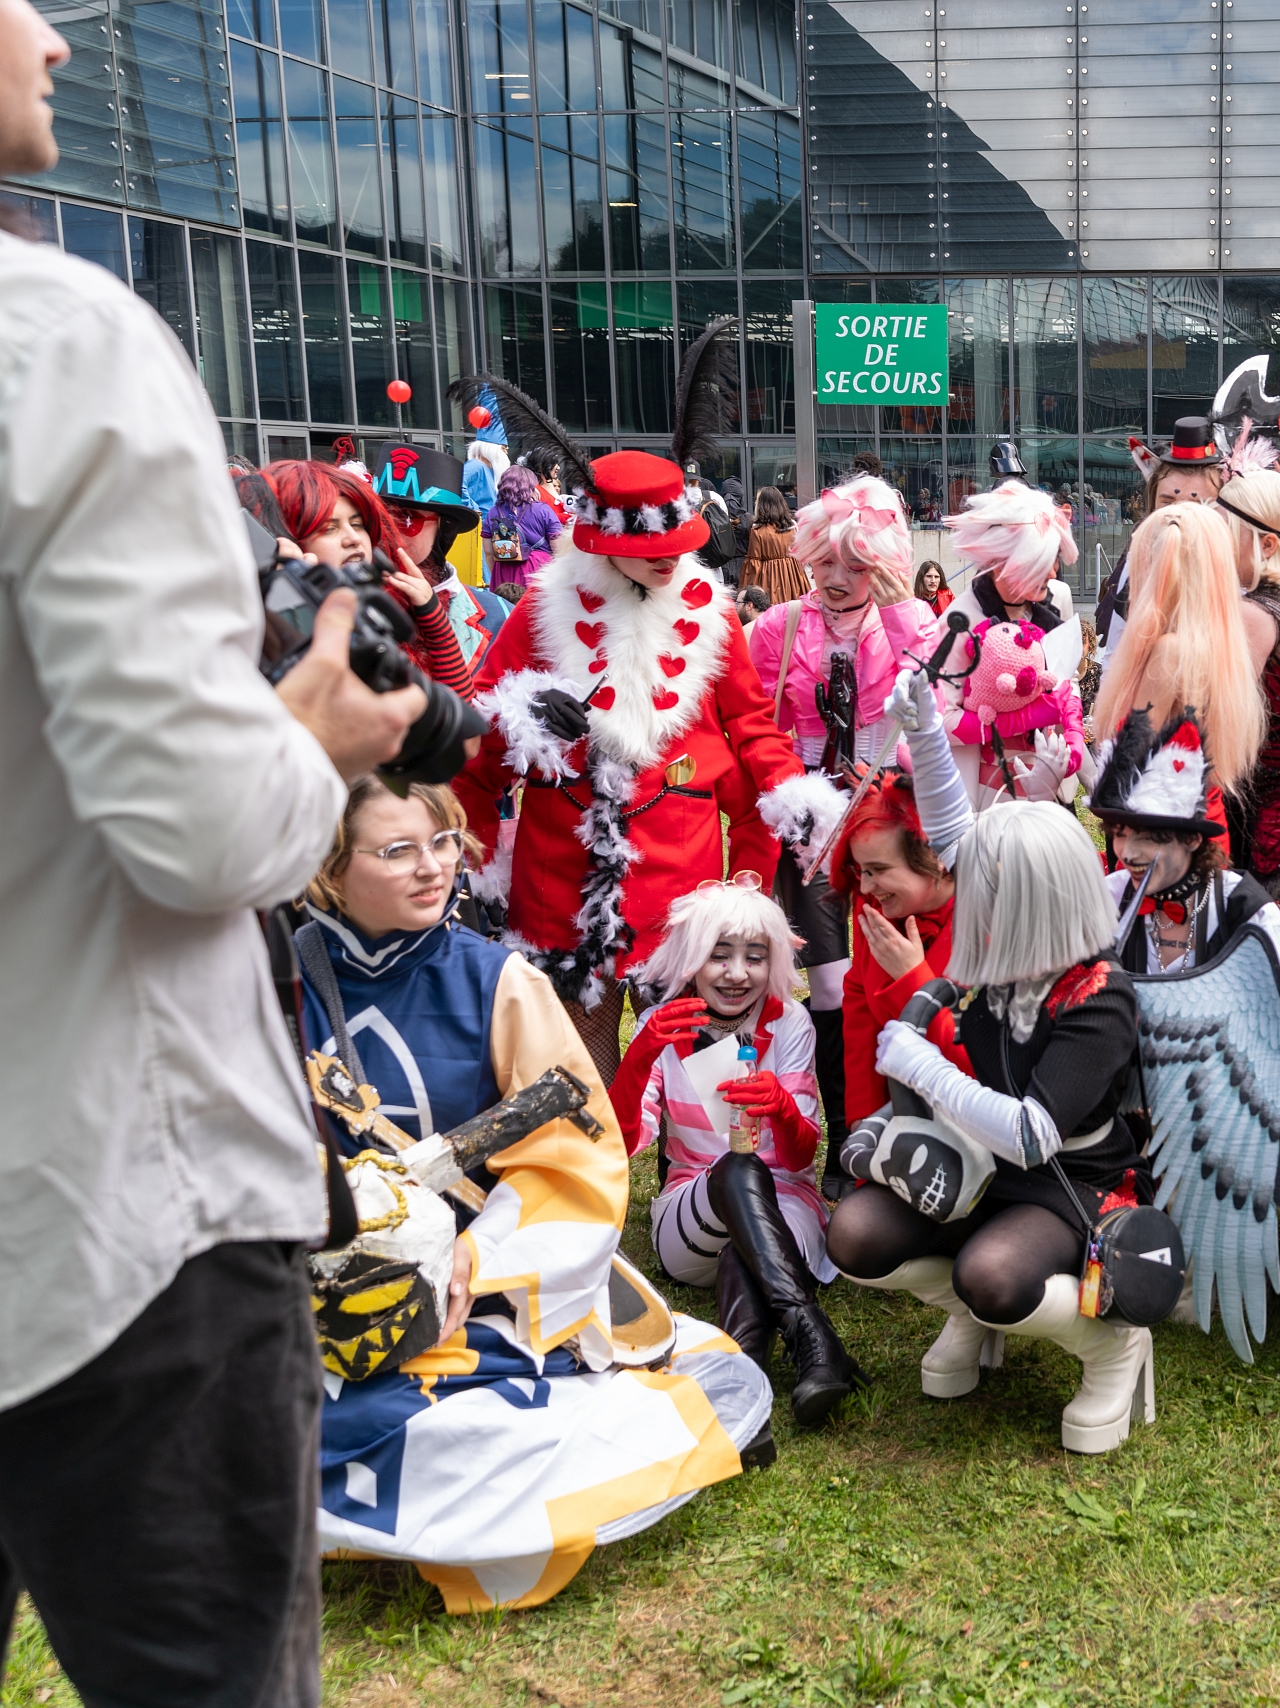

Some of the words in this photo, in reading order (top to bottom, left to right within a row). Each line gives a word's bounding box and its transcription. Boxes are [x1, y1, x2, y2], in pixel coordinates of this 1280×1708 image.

[835, 315, 928, 338] SORTIE
[864, 343, 899, 366] DE
[822, 370, 943, 394] SECOURS
